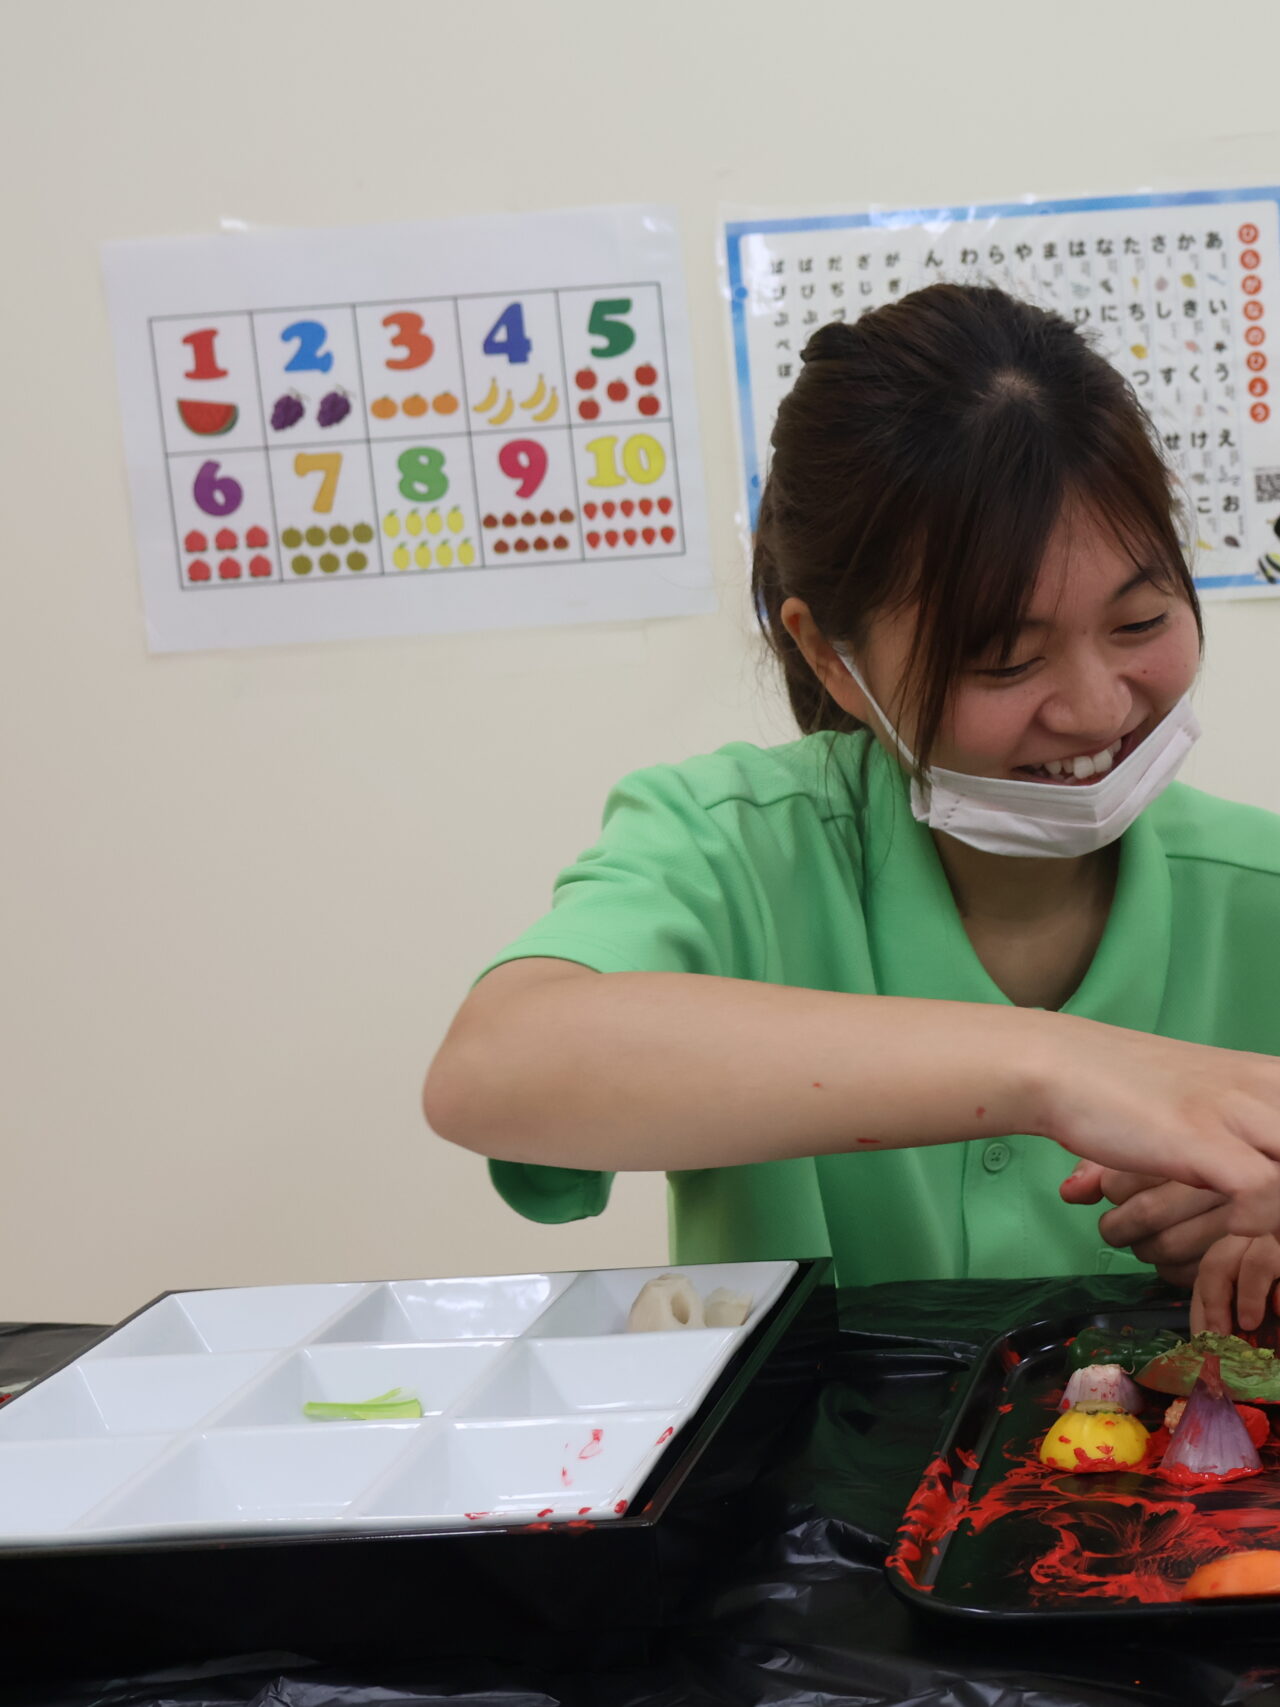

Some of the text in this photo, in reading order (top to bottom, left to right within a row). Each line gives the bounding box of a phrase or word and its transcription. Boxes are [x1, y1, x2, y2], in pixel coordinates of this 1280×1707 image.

[924, 231, 1223, 268] ん わ ら や ま は な た さ か あ
[1073, 307, 1091, 326] ひ
[1100, 305, 1119, 323] に
[1128, 302, 1145, 321] ち
[1156, 301, 1172, 320] し
[1183, 299, 1197, 318] き
[1209, 300, 1227, 315] い
[183, 300, 634, 380] 1 2 3 4 5
[1132, 362, 1230, 387] つ す く う
[1163, 428, 1235, 451] せ け え
[194, 434, 665, 515] 6 7 8 9 10
[1196, 496, 1212, 514] こ
[1222, 495, 1240, 513] お
